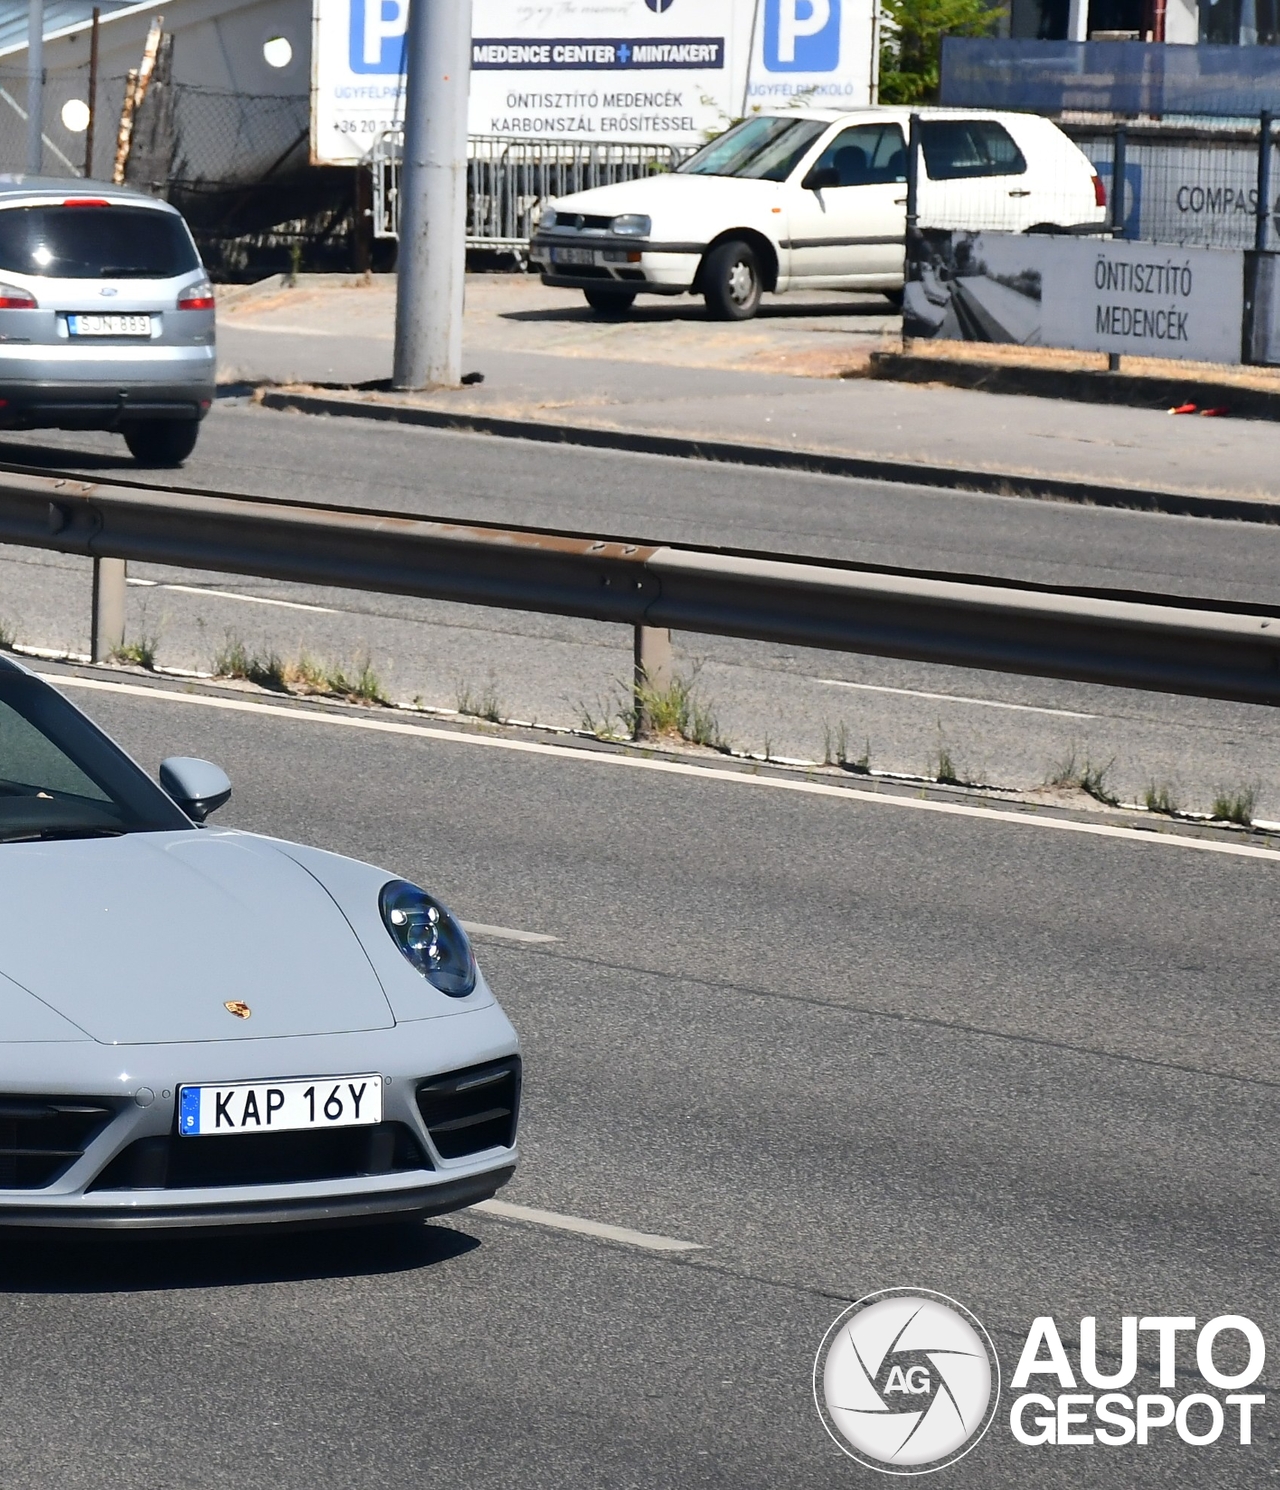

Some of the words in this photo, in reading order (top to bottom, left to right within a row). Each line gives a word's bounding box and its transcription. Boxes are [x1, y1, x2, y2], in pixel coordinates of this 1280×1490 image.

[473, 46, 551, 63] MEDENCE
[553, 45, 615, 63] CENTER
[632, 45, 719, 62] MINTAKERT
[506, 90, 599, 108] ÖNTISZTÍTÓ
[602, 90, 683, 108] MEDENCÉK
[361, 120, 376, 133] 20
[491, 114, 595, 132] KARBONSZÁL
[600, 112, 698, 132] ERŐSÍTÉSSEL
[1095, 254, 1192, 297] ÖNTISZTÍTÓ
[1096, 304, 1189, 341] MEDENCÉK
[215, 1089, 285, 1128] KAP
[303, 1083, 367, 1122] 16Y
[187, 1116, 194, 1126] S
